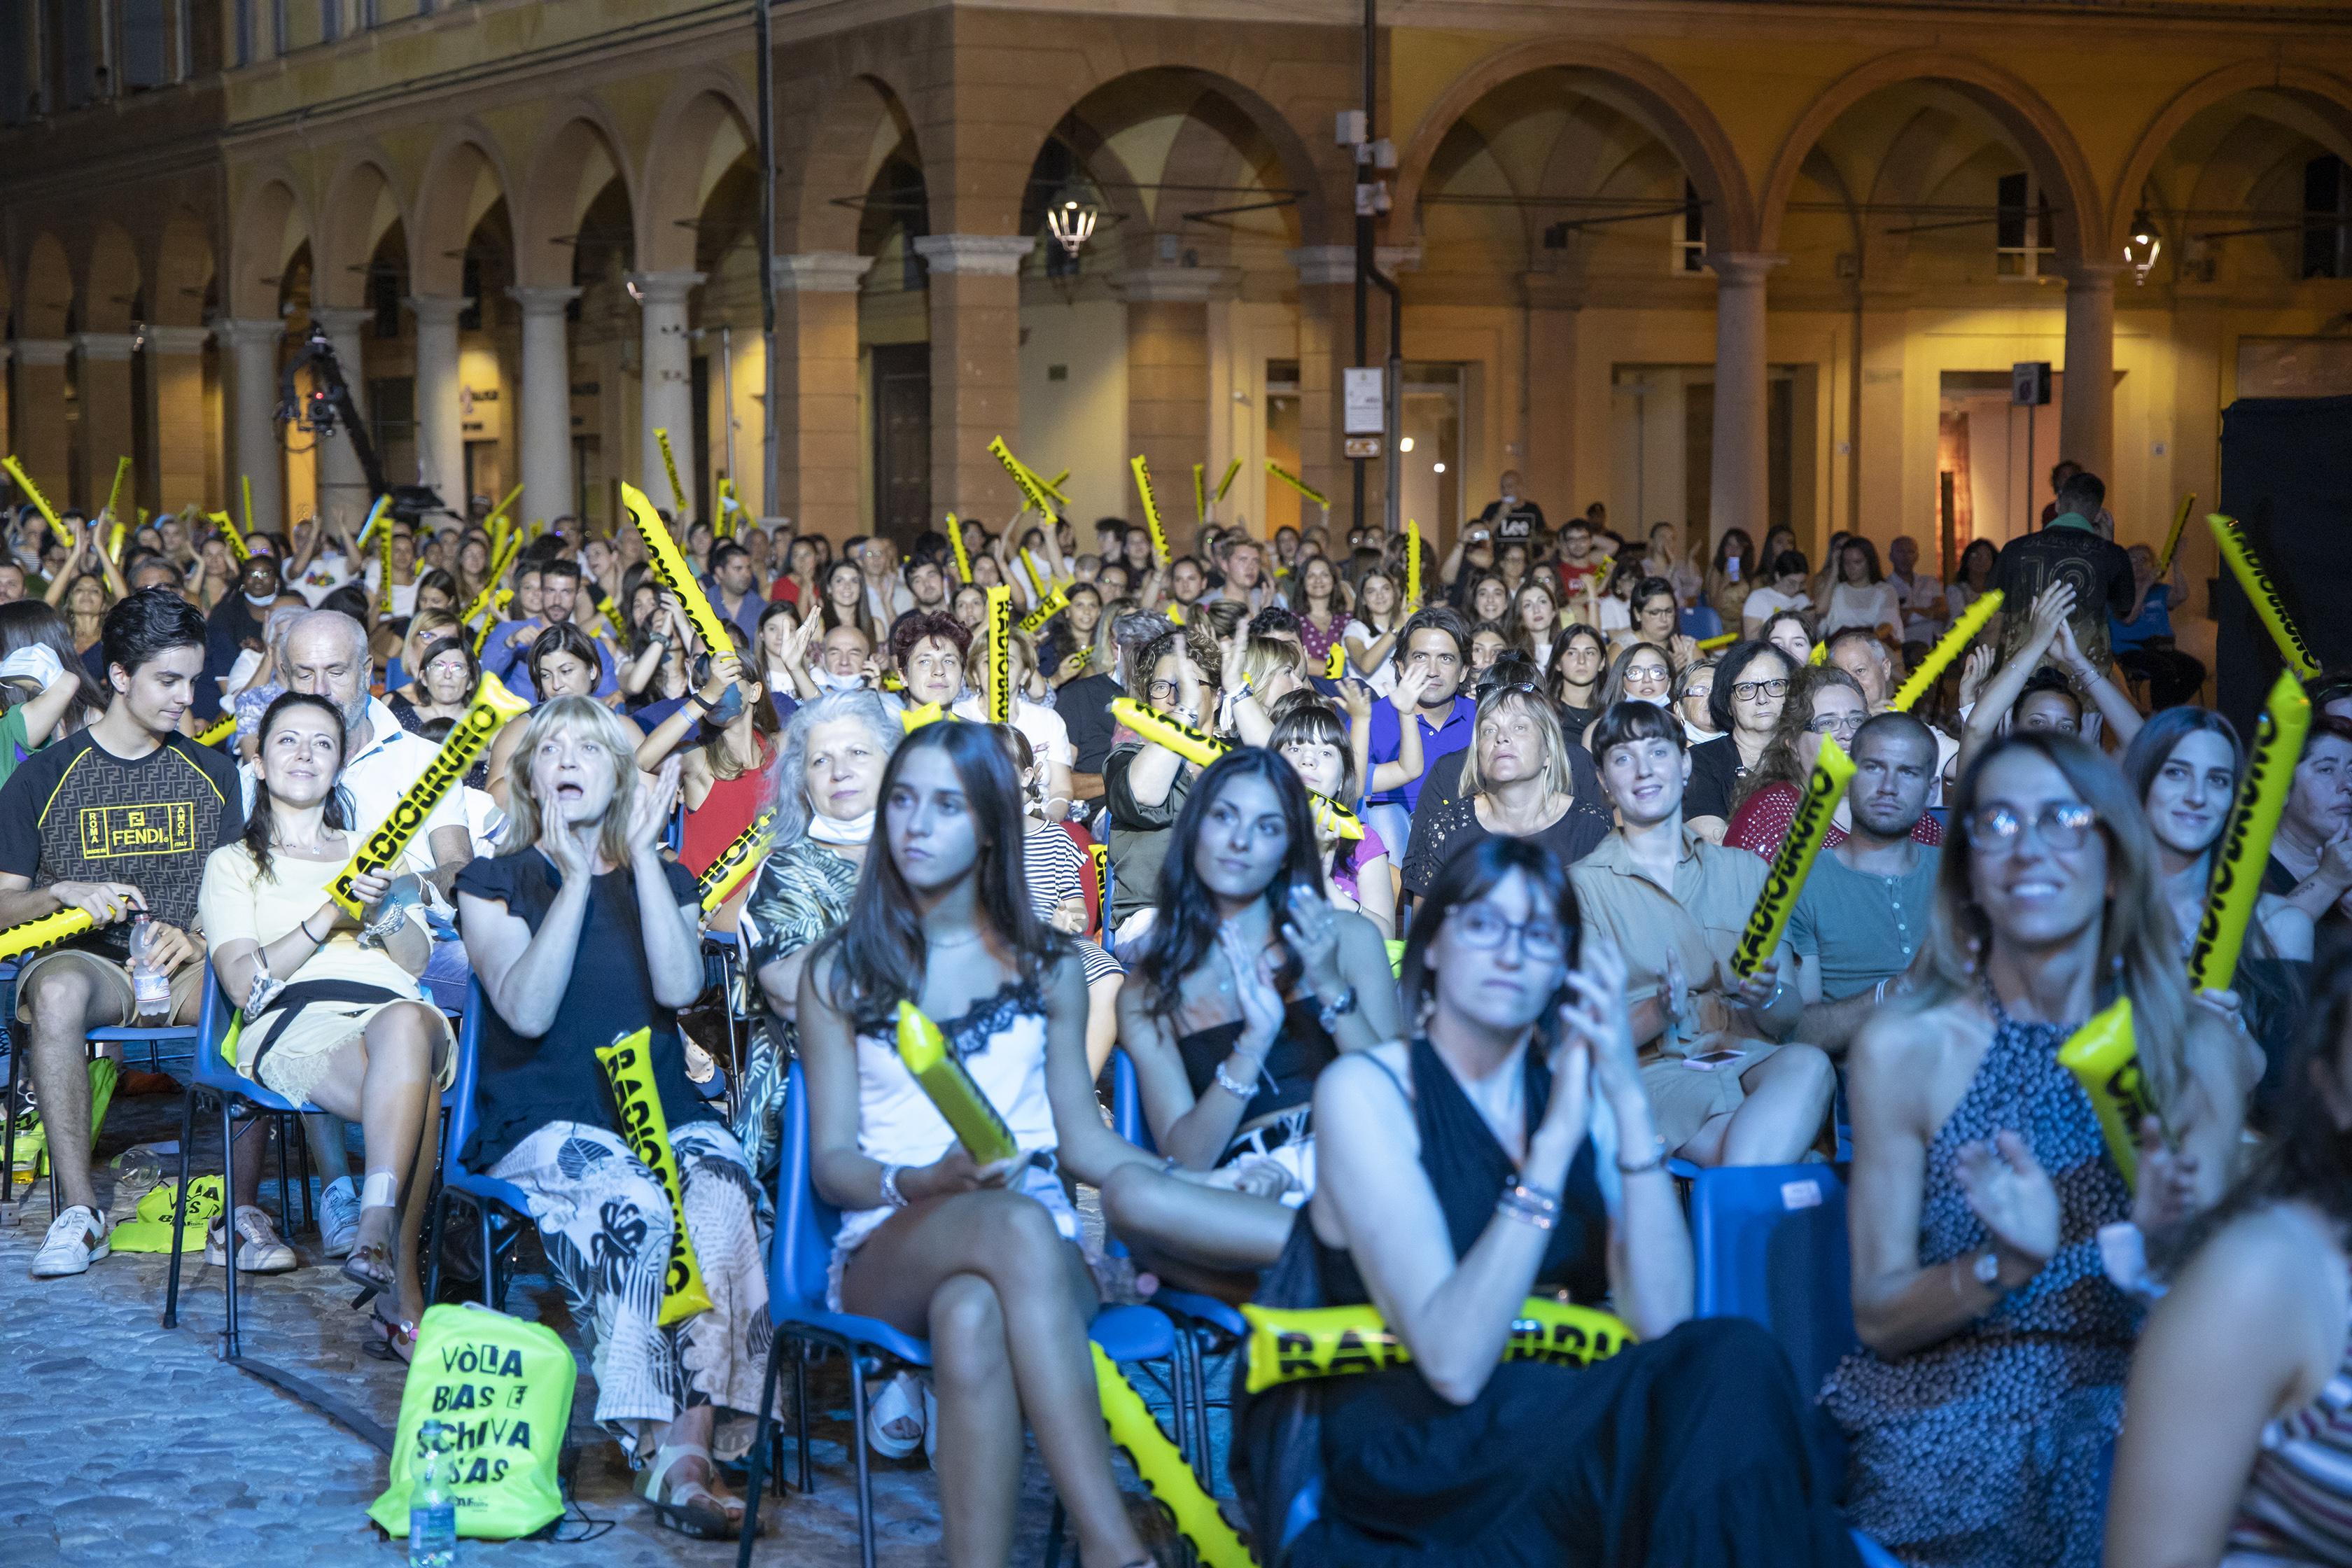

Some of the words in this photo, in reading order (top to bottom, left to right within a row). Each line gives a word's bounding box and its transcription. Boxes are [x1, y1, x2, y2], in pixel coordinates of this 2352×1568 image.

[1501, 519, 1530, 536] Lee
[89, 813, 99, 844] ROMA
[177, 806, 186, 836] AMOR
[113, 828, 163, 846] FENDI
[433, 1384, 495, 1413] BAS
